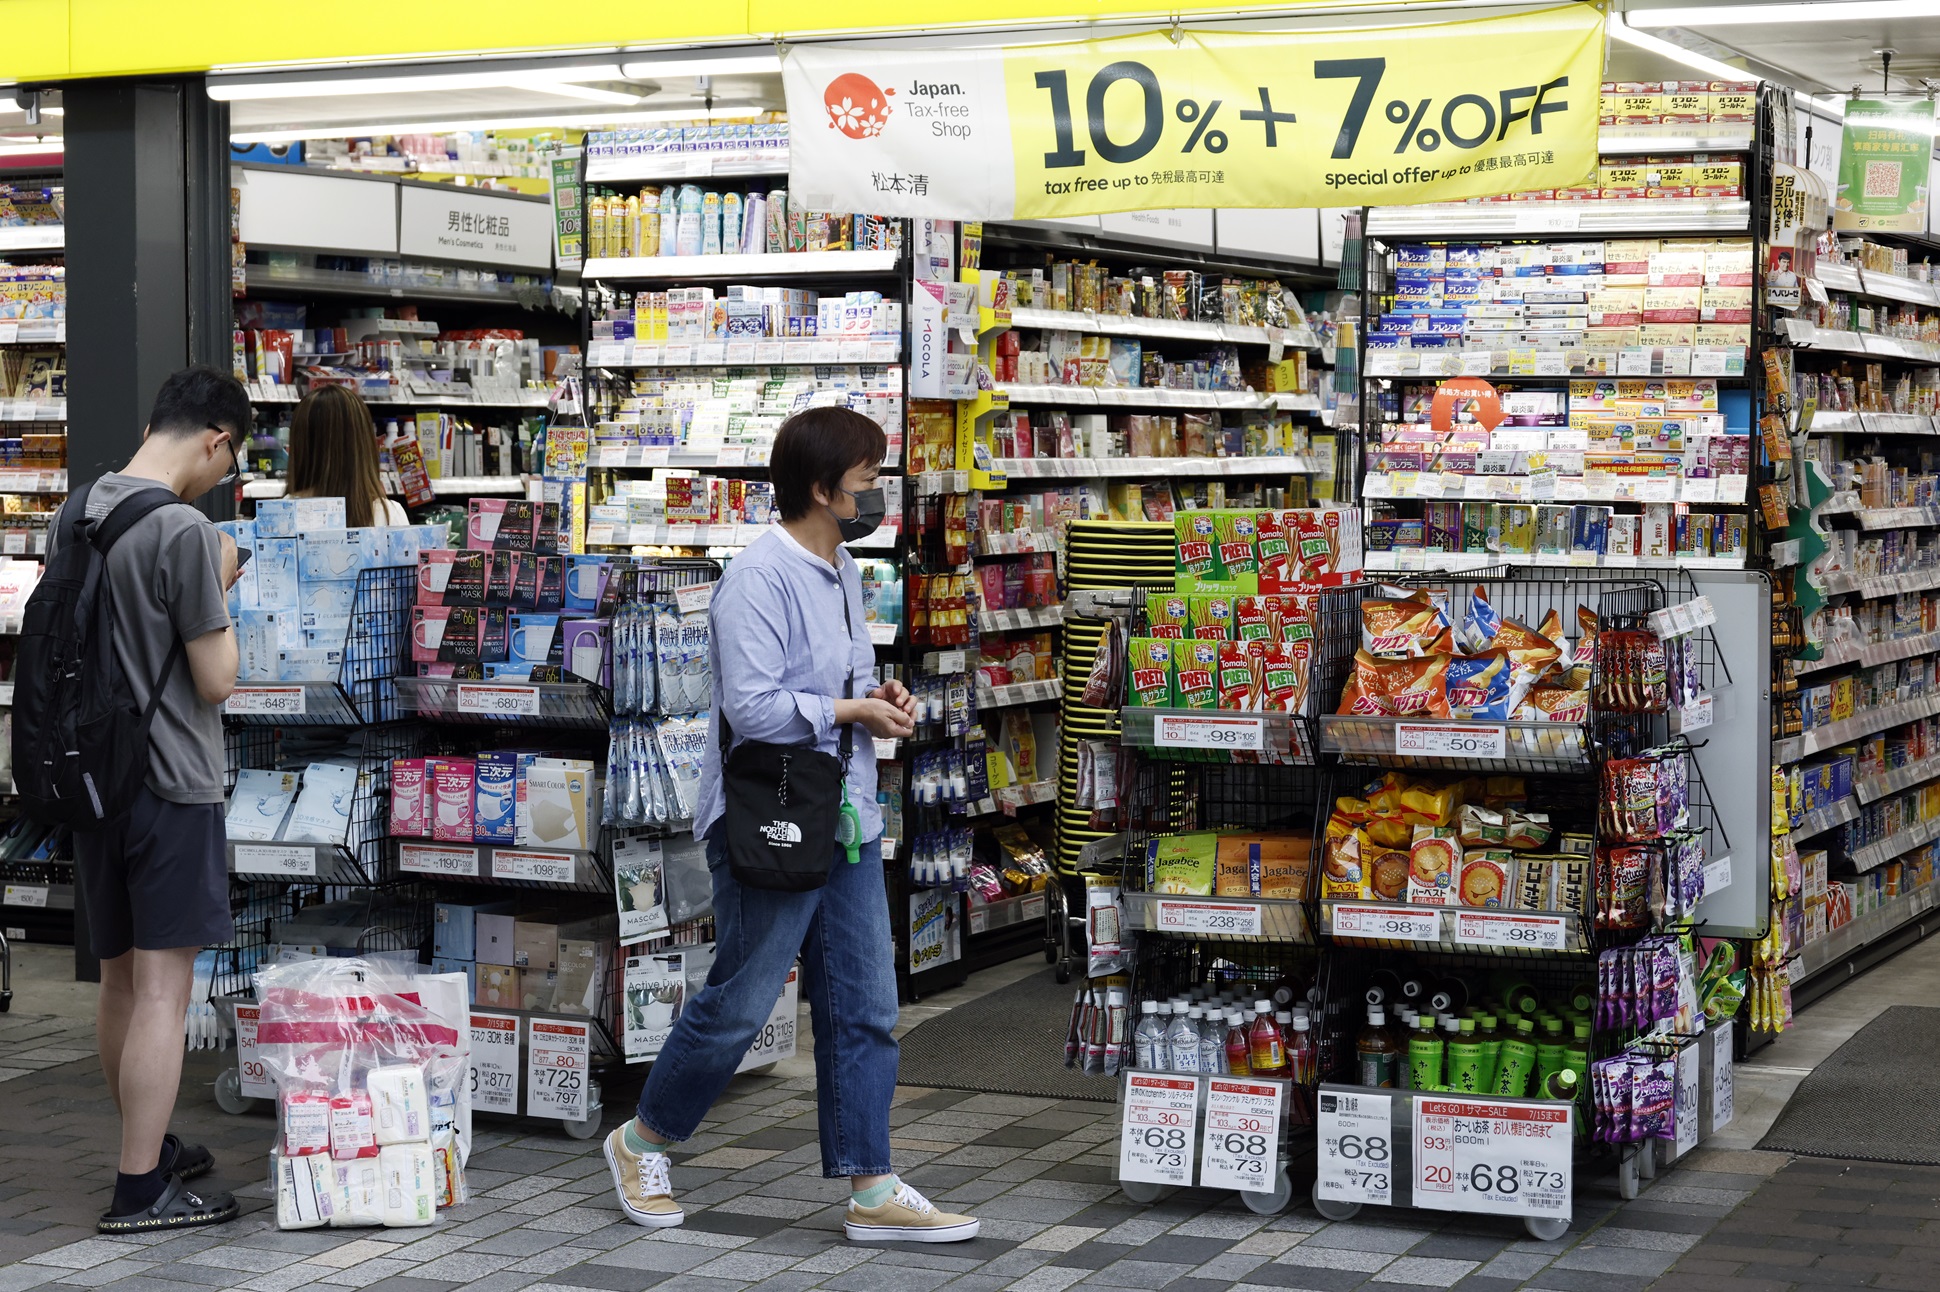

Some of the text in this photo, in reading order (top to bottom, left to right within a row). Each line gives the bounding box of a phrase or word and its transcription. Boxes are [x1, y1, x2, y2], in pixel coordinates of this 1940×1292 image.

[908, 80, 966, 97] Japan.
[904, 100, 970, 118] Tax-free
[932, 121, 972, 140] Shop
[1325, 149, 1555, 189] special offer up to 優惠最高可達
[871, 171, 930, 197] 松本清
[1045, 181, 1071, 195] tax
[1074, 175, 1109, 193] free
[1112, 175, 1131, 191] up
[1133, 174, 1149, 187] to
[1784, 175, 1794, 228] ダルい体に
[448, 210, 510, 238] 男性化粧品
[1131, 212, 1161, 225] Health Foods
[437, 236, 484, 249] Men's Cosmetics
[1397, 286, 1430, 295] アレジオン
[1447, 285, 1478, 294] アレジオン
[1772, 290, 1799, 298] ヘパリーゼ
[922, 318, 931, 379] MOCOLA
[1483, 465, 1506, 473] 鼻炎薬
[1372, 531, 1393, 539] EX
[509, 540, 530, 548] MASK
[1260, 540, 1287, 558] PRETZ
[1301, 540, 1328, 558] PRETZ
[1180, 543, 1210, 560] PRETZ
[1220, 543, 1251, 561] PRETZ
[1194, 582, 1220, 592] プリッツ
[1298, 582, 1323, 592] プリッツ
[460, 590, 482, 598] MASK
[1239, 615, 1266, 624] Tomato
[1281, 615, 1308, 624] Tomato
[1371, 634, 1413, 651] クリスプ
[455, 647, 475, 655] MASK
[1221, 660, 1248, 668] Tomato
[1265, 662, 1292, 670] Tomato
[1135, 670, 1165, 689] PRETZ
[1180, 670, 1211, 690] PRETZ
[265, 698, 285, 708] 648
[497, 698, 518, 708] 680
[1393, 690, 1430, 713] クリスプ
[1450, 689, 1488, 706] クリスプ
[1211, 730, 1236, 742] 98
[1450, 739, 1477, 751] 50
[1483, 741, 1495, 749] 54
[478, 766, 513, 778] 三次元
[989, 755, 1001, 786] コラーゲン
[394, 772, 422, 782] 三次元
[436, 777, 471, 788] 三次元
[528, 779, 566, 789] SMART COLOR
[773, 820, 788, 828] THE
[760, 826, 788, 835] NORTH
[767, 833, 787, 841] FACE
[283, 859, 296, 867] 498
[439, 858, 458, 868] 1190
[1156, 857, 1200, 869] Jagabee
[533, 865, 553, 875] 1098
[1262, 865, 1309, 878] Jagabee
[1350, 871, 1359, 879] 32
[1251, 863, 1260, 892] 大容量
[1412, 889, 1447, 897] ハーベスト
[1209, 916, 1235, 927] 238
[1386, 921, 1412, 933] 98
[1418, 924, 1431, 932] 105
[1510, 928, 1537, 941] 98
[628, 979, 683, 991] Active Duo
[242, 1010, 255, 1018] Let's
[487, 1019, 511, 1030] 7/15まで
[781, 1021, 793, 1037] 105
[242, 1037, 256, 1048] 547
[471, 1030, 515, 1045] マスク 30枚 各種
[556, 1056, 575, 1067] 80
[244, 1061, 263, 1077] 30
[490, 1072, 512, 1087] 877
[546, 1069, 580, 1089] 725
[1720, 1061, 1731, 1090] 348
[556, 1092, 577, 1104] 797
[1429, 1104, 1561, 1120] Let's サマーSALE 7/15まで
[1137, 1112, 1180, 1125] 103 30
[1338, 1120, 1359, 1128] 600ml
[1425, 1116, 1450, 1124] 表示価格
[1217, 1118, 1260, 1132] 103 30
[1493, 1121, 1553, 1138] お1人様計3点まで
[1129, 1127, 1186, 1150] 本体 68
[1209, 1133, 1267, 1156] 本体 68
[1424, 1136, 1445, 1150] 93
[1455, 1135, 1490, 1145] 600ml
[1325, 1135, 1389, 1161] 本体 68
[1155, 1152, 1181, 1167] 73
[1235, 1158, 1262, 1173] 73
[1520, 1159, 1548, 1168] (税率8%)
[1358, 1171, 1389, 1190] 73
[1425, 1165, 1452, 1184] 20
[1455, 1163, 1519, 1194] 本体 68
[1523, 1169, 1564, 1189] 税込 73
[1495, 1195, 1518, 1203] Excluded)
